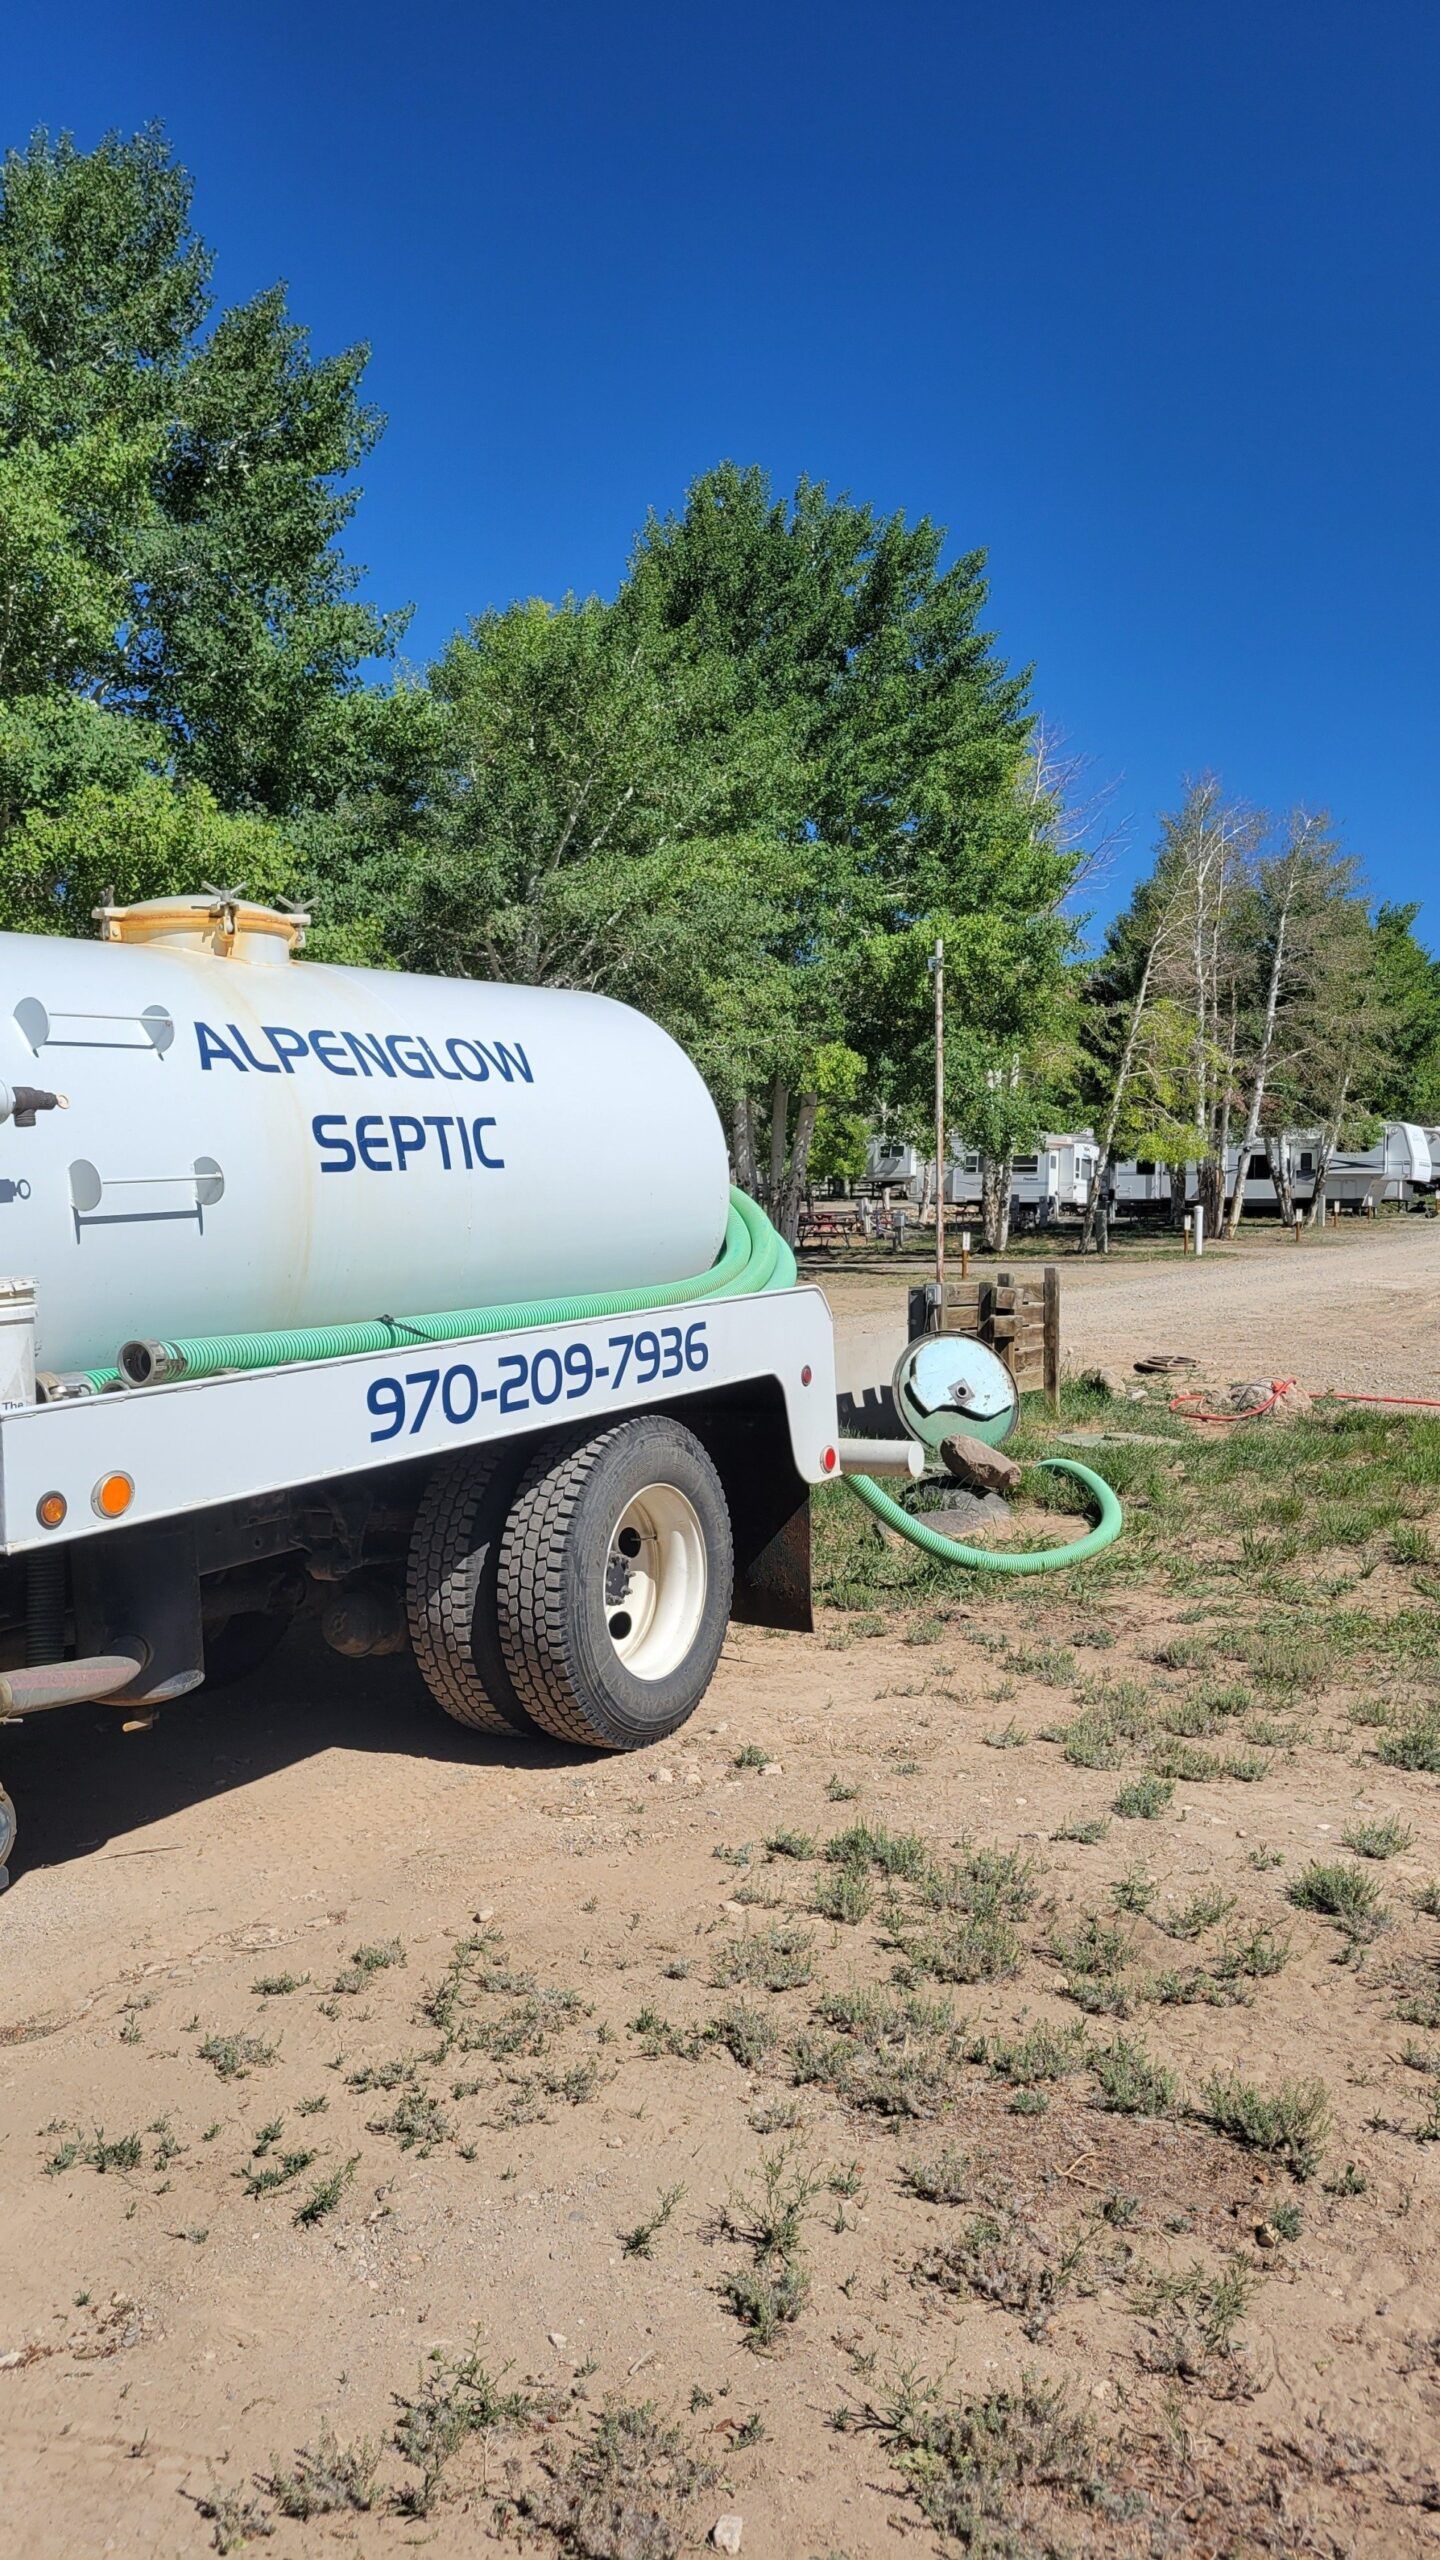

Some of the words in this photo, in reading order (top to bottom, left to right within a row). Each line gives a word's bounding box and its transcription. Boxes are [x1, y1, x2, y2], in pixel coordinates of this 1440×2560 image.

[194, 1022, 534, 1083] ALPENGLOW
[312, 1114, 505, 1173] SEPTIC
[367, 1322, 709, 1443] 970-209-7936
